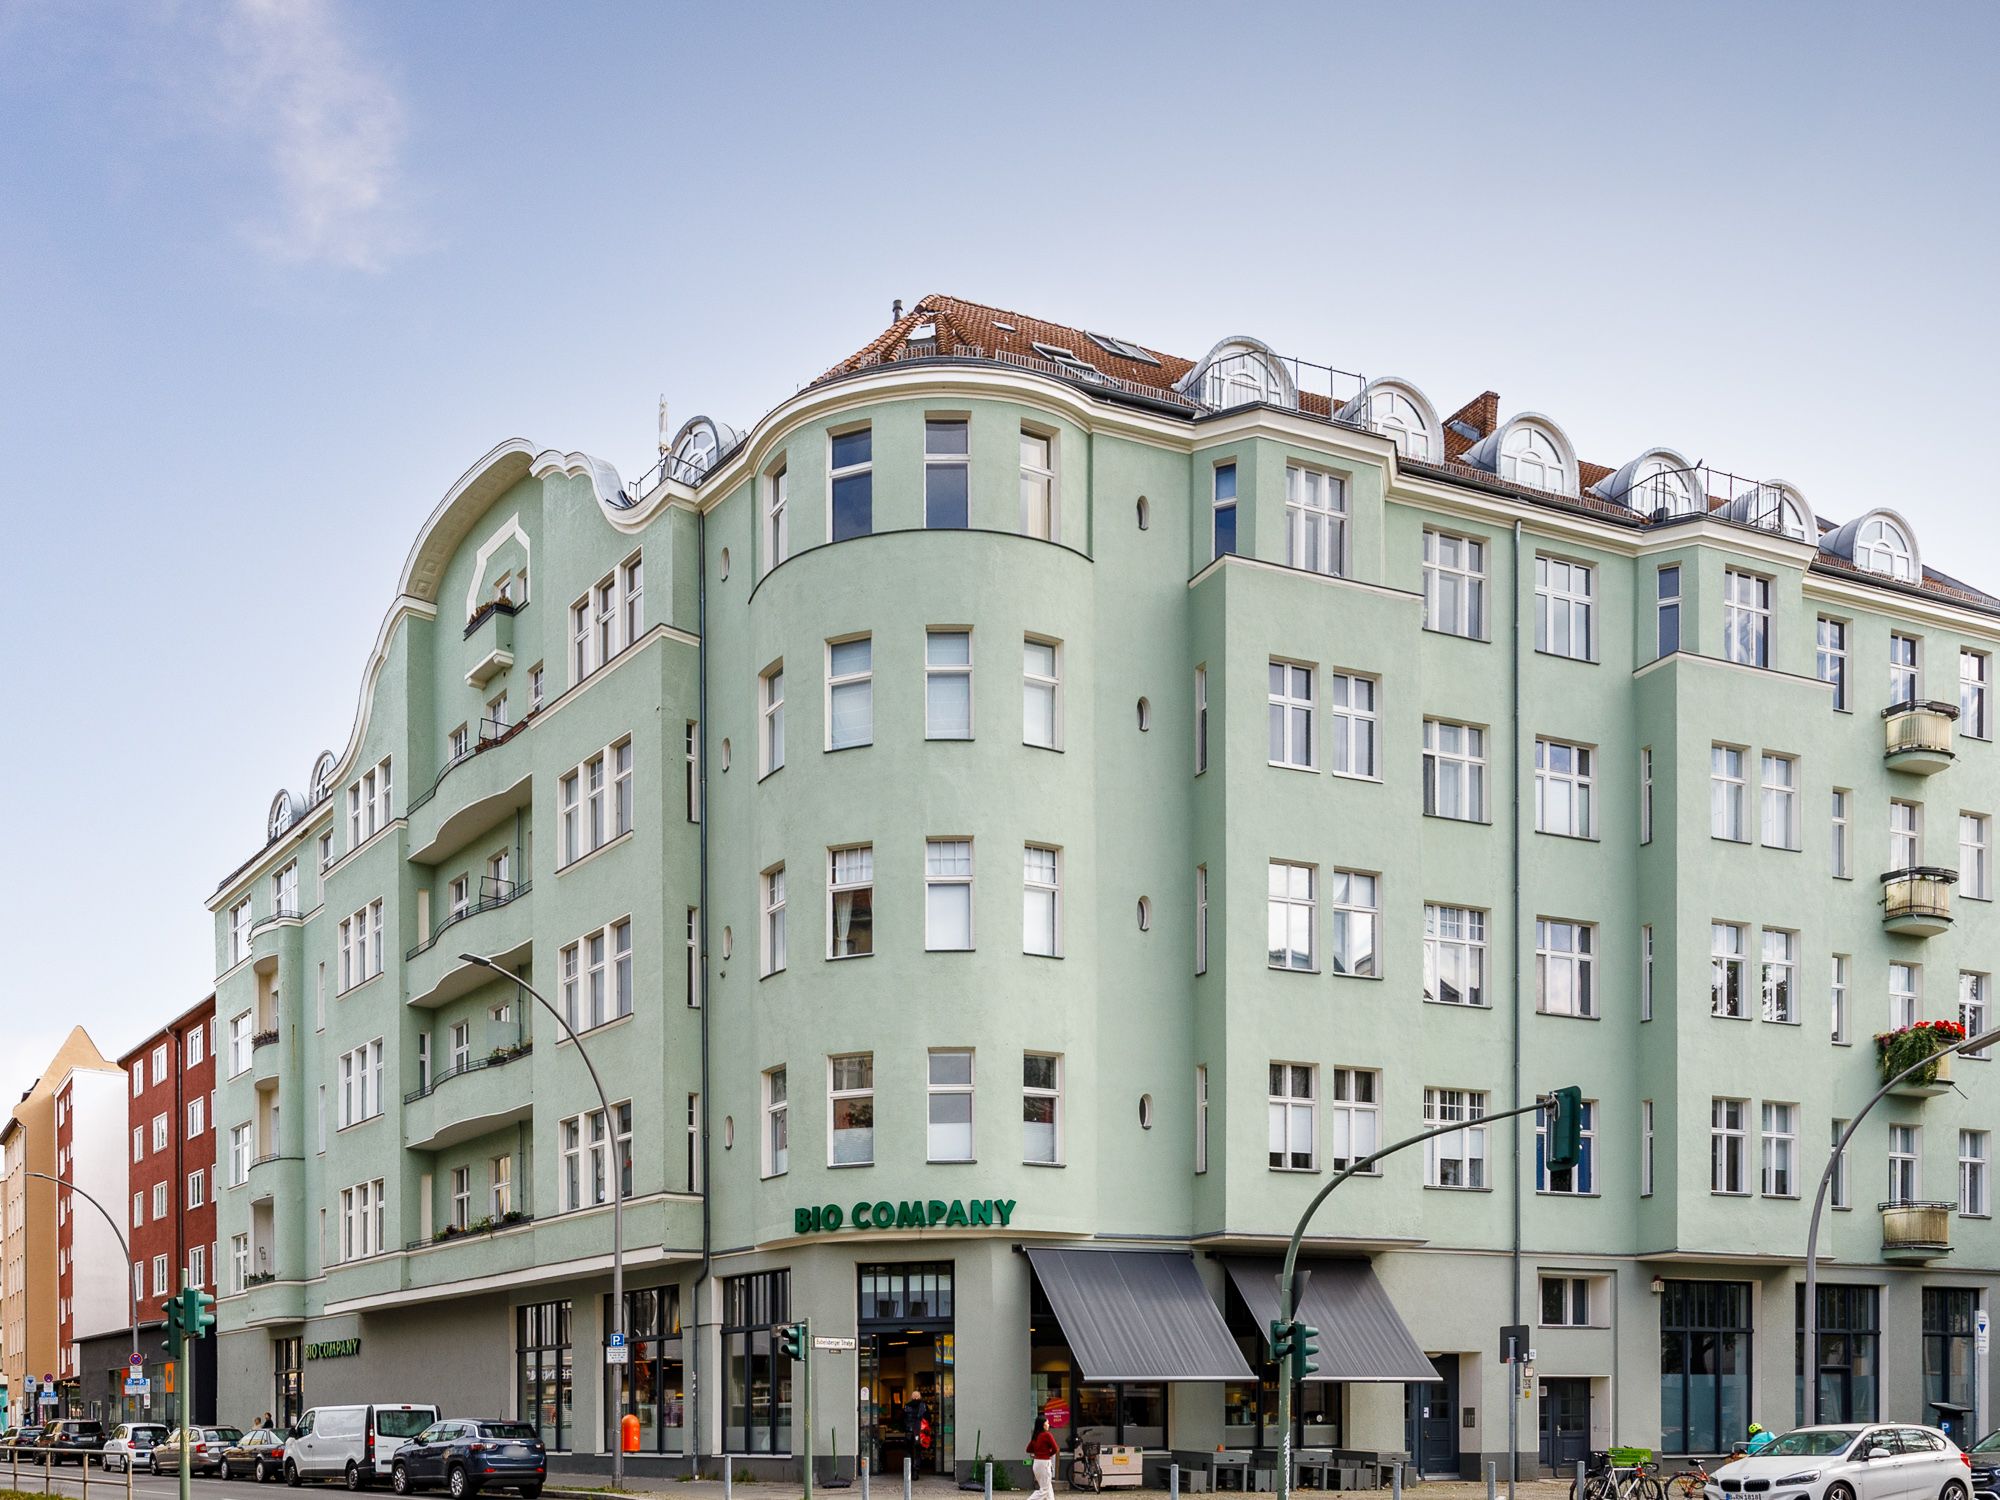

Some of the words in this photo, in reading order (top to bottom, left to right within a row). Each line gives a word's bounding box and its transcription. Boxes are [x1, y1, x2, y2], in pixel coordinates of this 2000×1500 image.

[795, 1204, 843, 1233] BIO
[851, 1199, 1017, 1229] COMPANY
[612, 1335, 621, 1346] P
[305, 1344, 319, 1360] BIO
[319, 1338, 360, 1358] COMPANY
[1941, 1422, 1949, 1431] P
